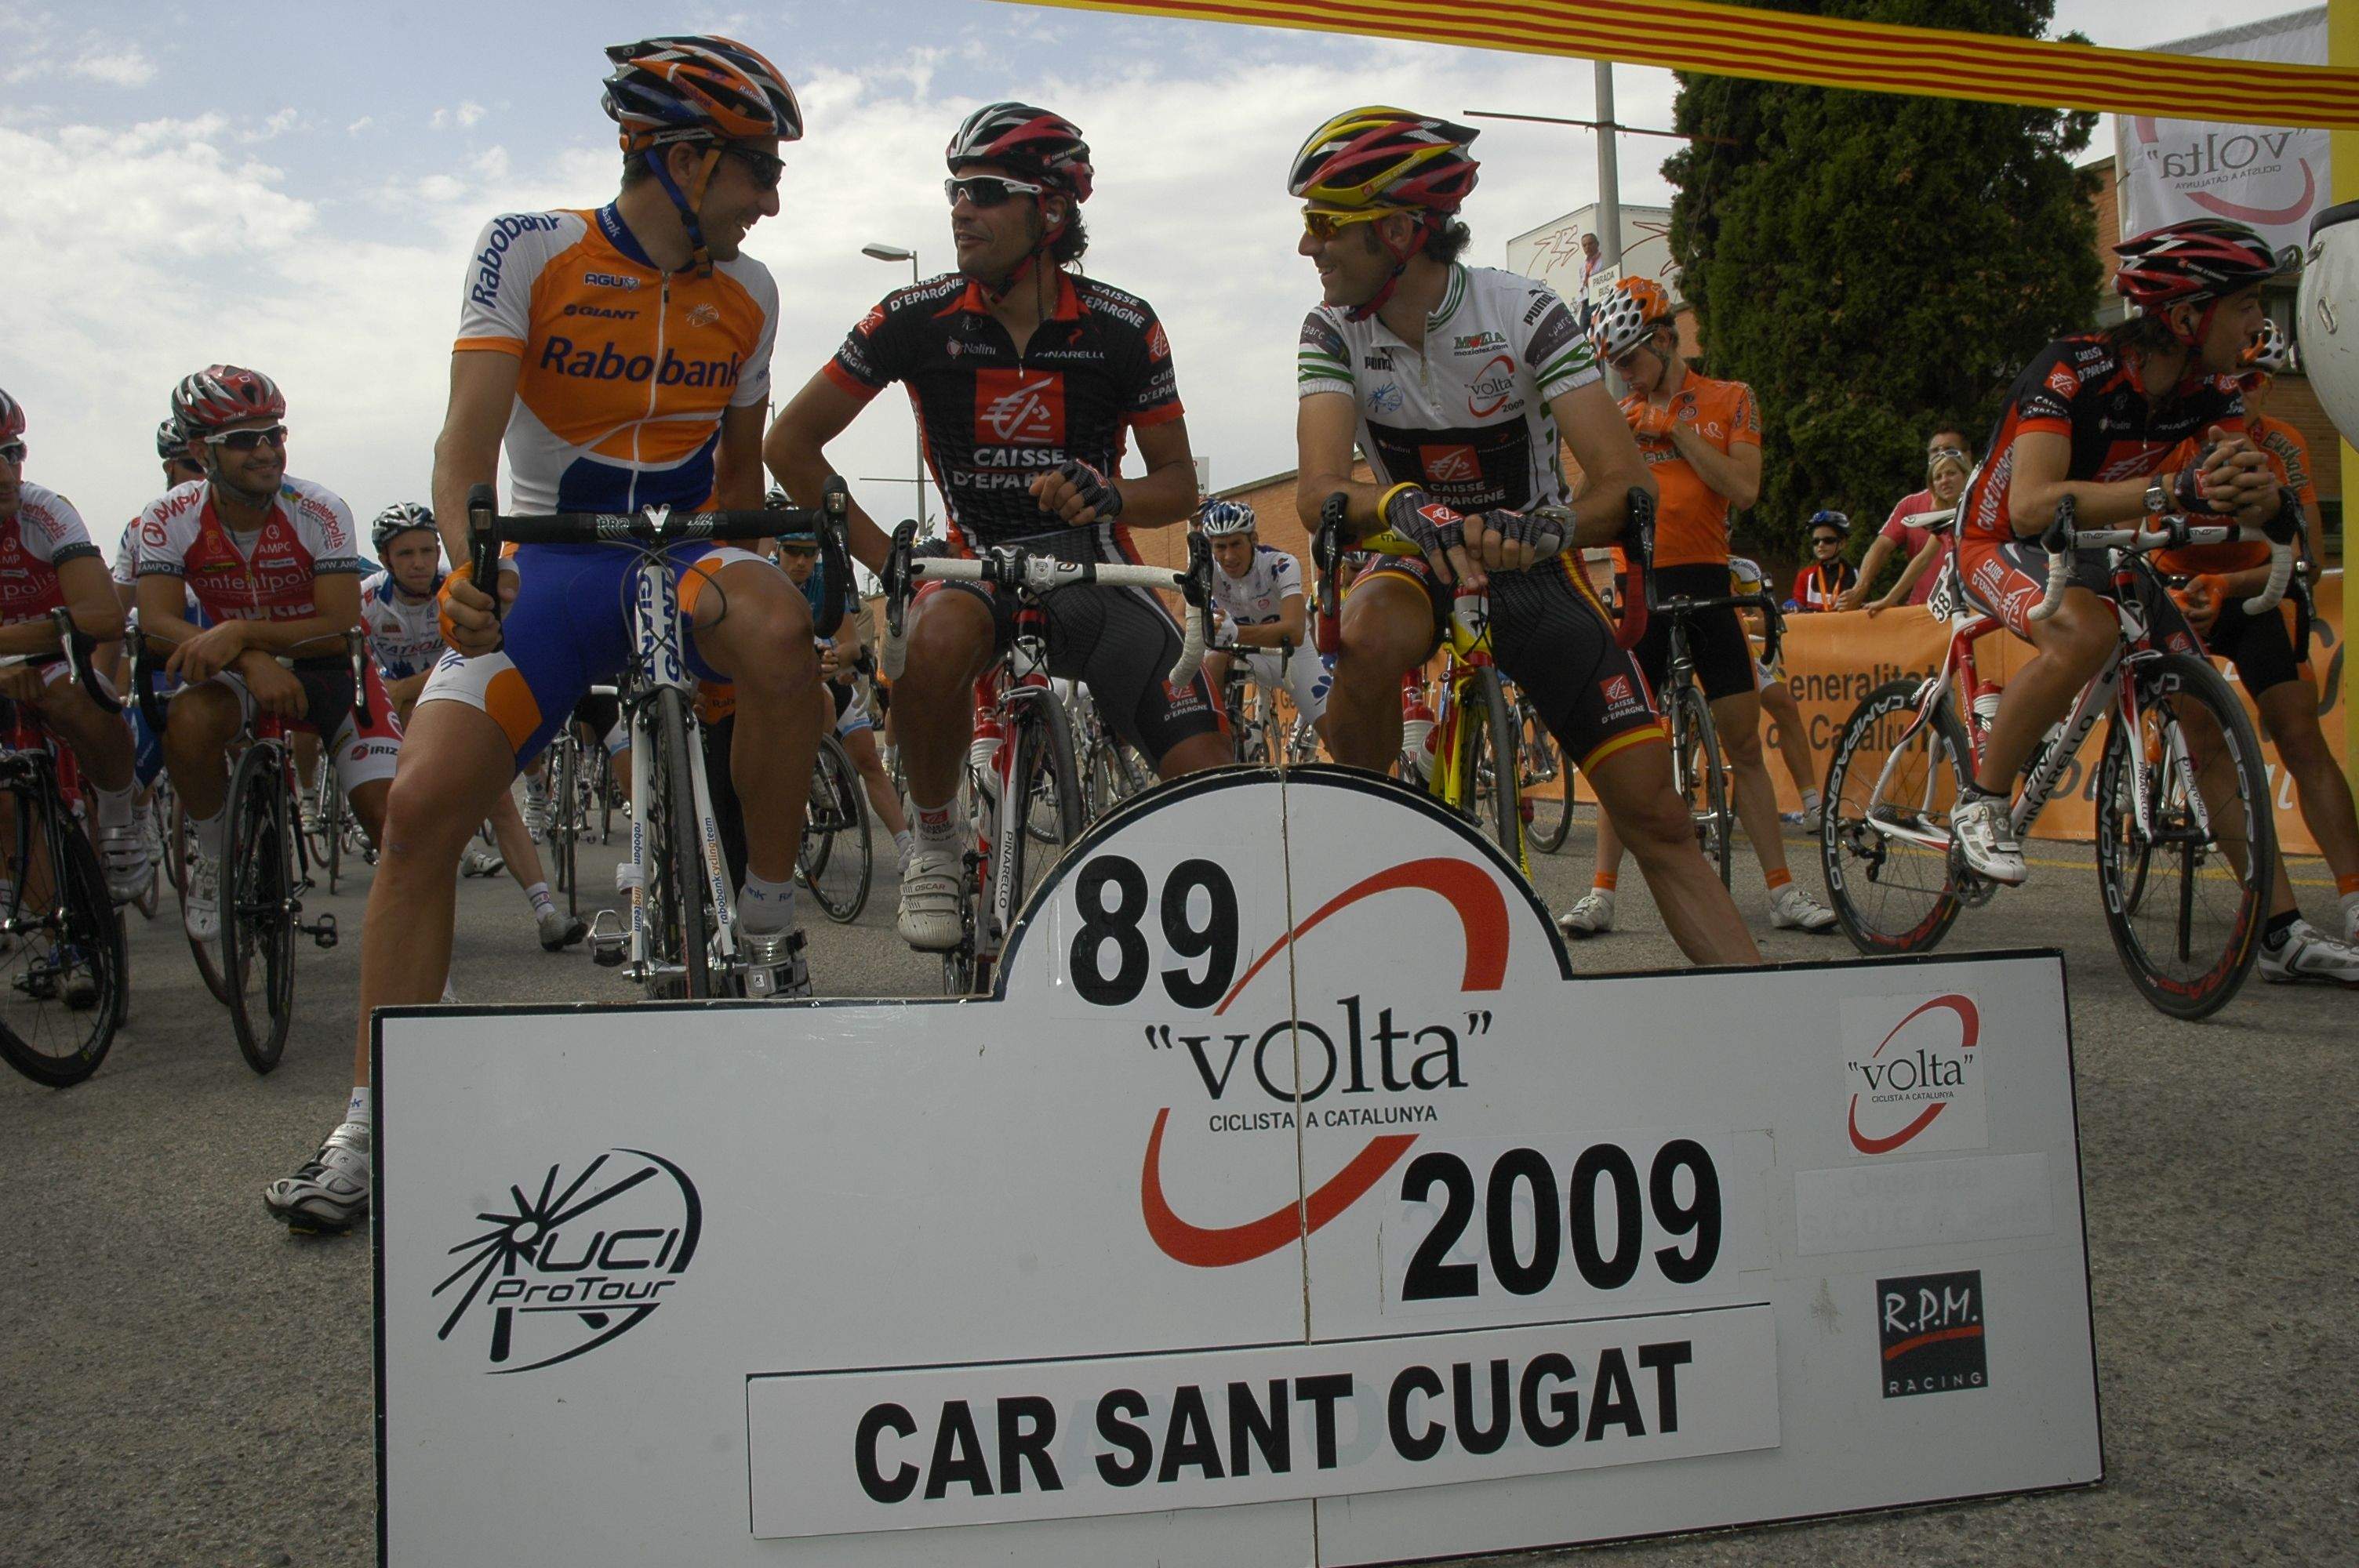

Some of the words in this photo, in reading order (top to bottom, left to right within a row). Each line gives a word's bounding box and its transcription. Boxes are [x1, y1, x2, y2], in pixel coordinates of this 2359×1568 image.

[471, 214, 560, 310] Rabobank
[584, 273, 624, 288] AGU
[1593, 271, 1615, 288] PARADA
[889, 278, 966, 312] D'EPARGNE
[1091, 284, 1140, 307] CAISSE
[578, 305, 641, 321] GIANT
[962, 343, 997, 355] Nalini
[540, 336, 743, 387] Rabobank
[1502, 398, 1525, 413] 2009
[973, 448, 1067, 467] CAISSE
[952, 470, 1040, 489] D'EPAR
[1430, 481, 1485, 493] CAISSE
[1432, 489, 1507, 506] EPARGNE
[301, 497, 346, 549] contentpolis
[196, 566, 313, 592] ontentpoli
[1931, 592, 1952, 622] 38
[1790, 664, 1938, 702] eneralitat
[1164, 702, 1209, 721] D'EPARGNE
[1170, 696, 1199, 710] CAISSE
[1601, 704, 1645, 724] D'EPARGNE
[1607, 695, 1636, 711] CAISSE
[370, 746, 398, 755] IRIZ
[2015, 715, 2095, 837] PINARELLO
[2138, 761, 2150, 821] PINARELLO
[998, 830, 1013, 909] PINARELLO
[914, 883, 946, 891] OSCAR
[1069, 855, 1239, 1009] 89
[1871, 1093, 1903, 1104] CICLISTA
[1912, 1091, 1955, 1102] CATALUNYA
[1209, 1111, 1295, 1133] CICLISTA
[1306, 1110, 1320, 1128] A
[1324, 1105, 1438, 1127] CATALUNYA
[1400, 1138, 1722, 1302] 2009
[536, 1228, 680, 1272] UCI
[487, 1276, 677, 1306] ProTour
[1885, 1287, 1979, 1334] R.P.M.
[1889, 1371, 1983, 1395] RACING
[855, 1395, 1063, 1505] CAR
[1092, 1371, 1356, 1490] SANT
[1387, 1340, 1693, 1462] CUGAT
